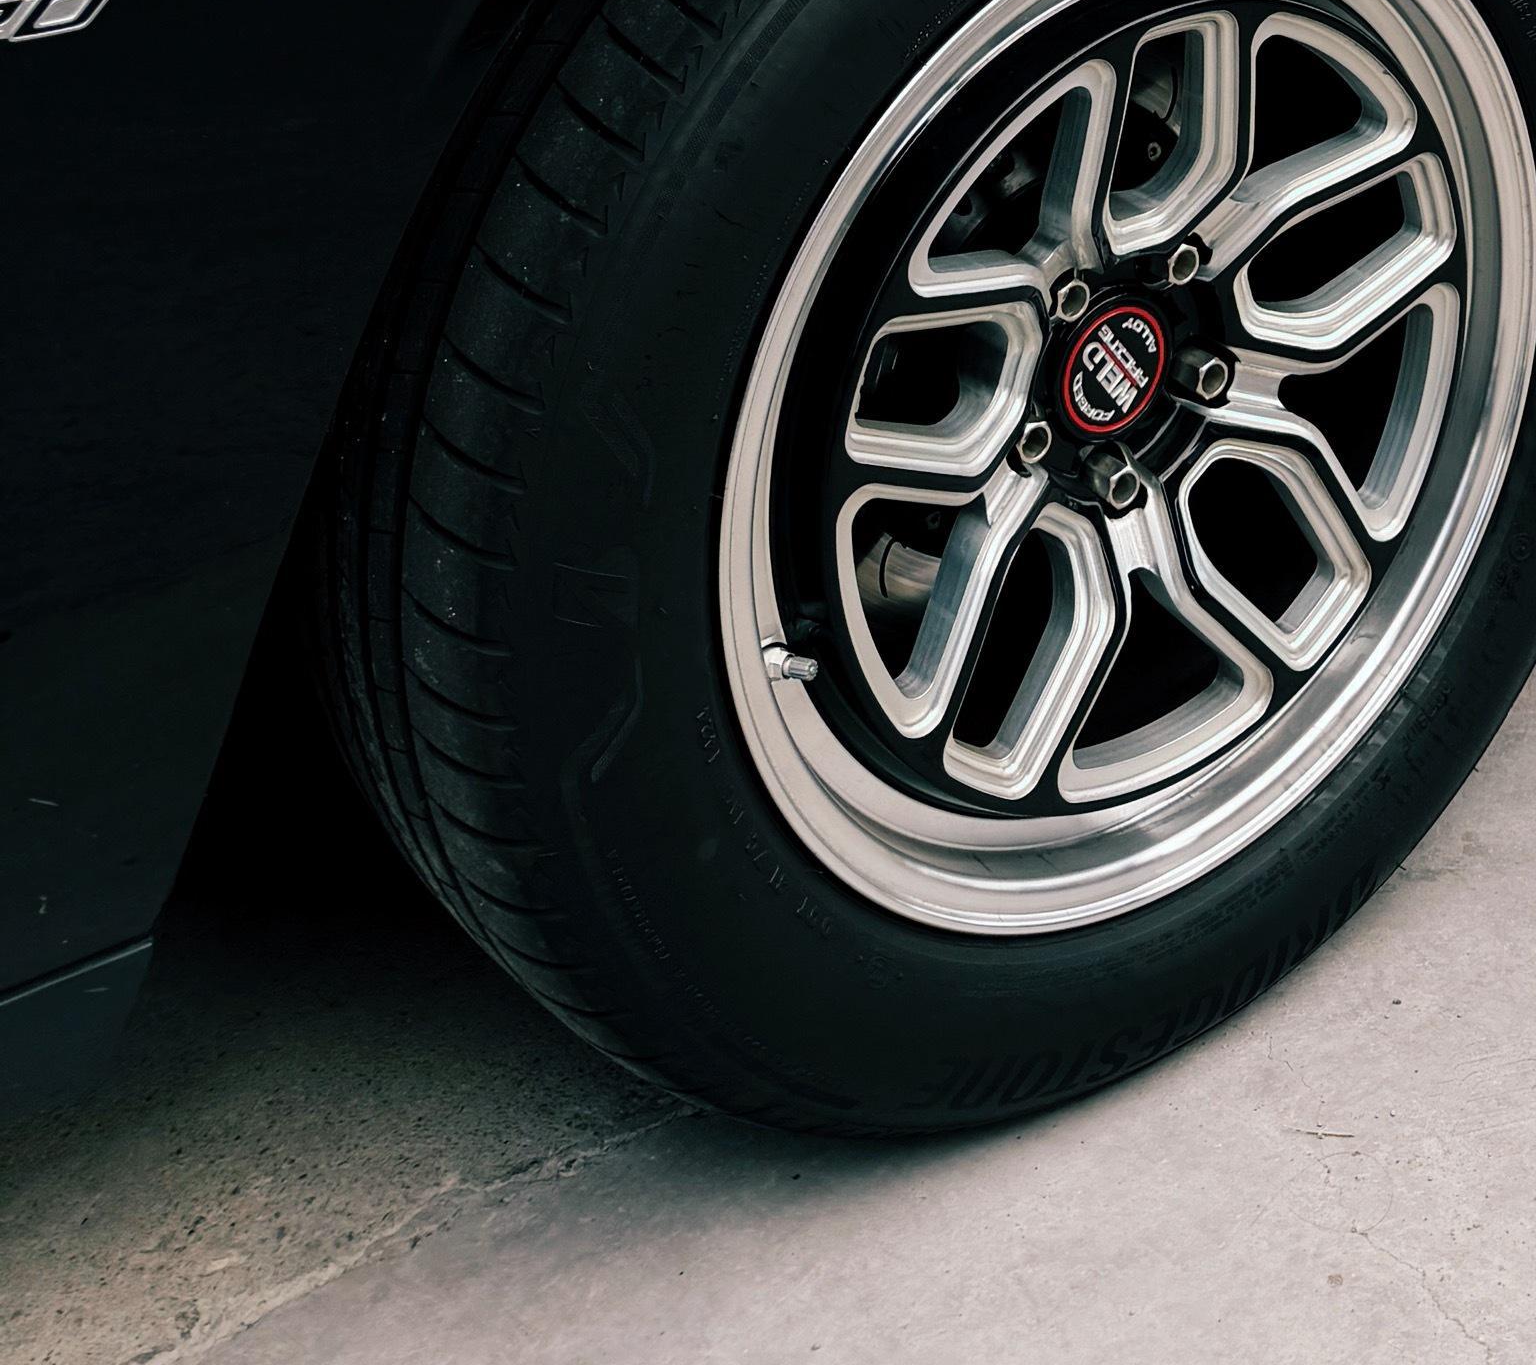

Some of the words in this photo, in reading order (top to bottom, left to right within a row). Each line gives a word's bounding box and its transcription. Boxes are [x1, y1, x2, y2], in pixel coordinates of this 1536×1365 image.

[1098, 324, 1150, 389] RACING
[1122, 317, 1158, 354] ALLOY
[1073, 372, 1116, 423] FORGED
[1082, 342, 1138, 414] WELD
